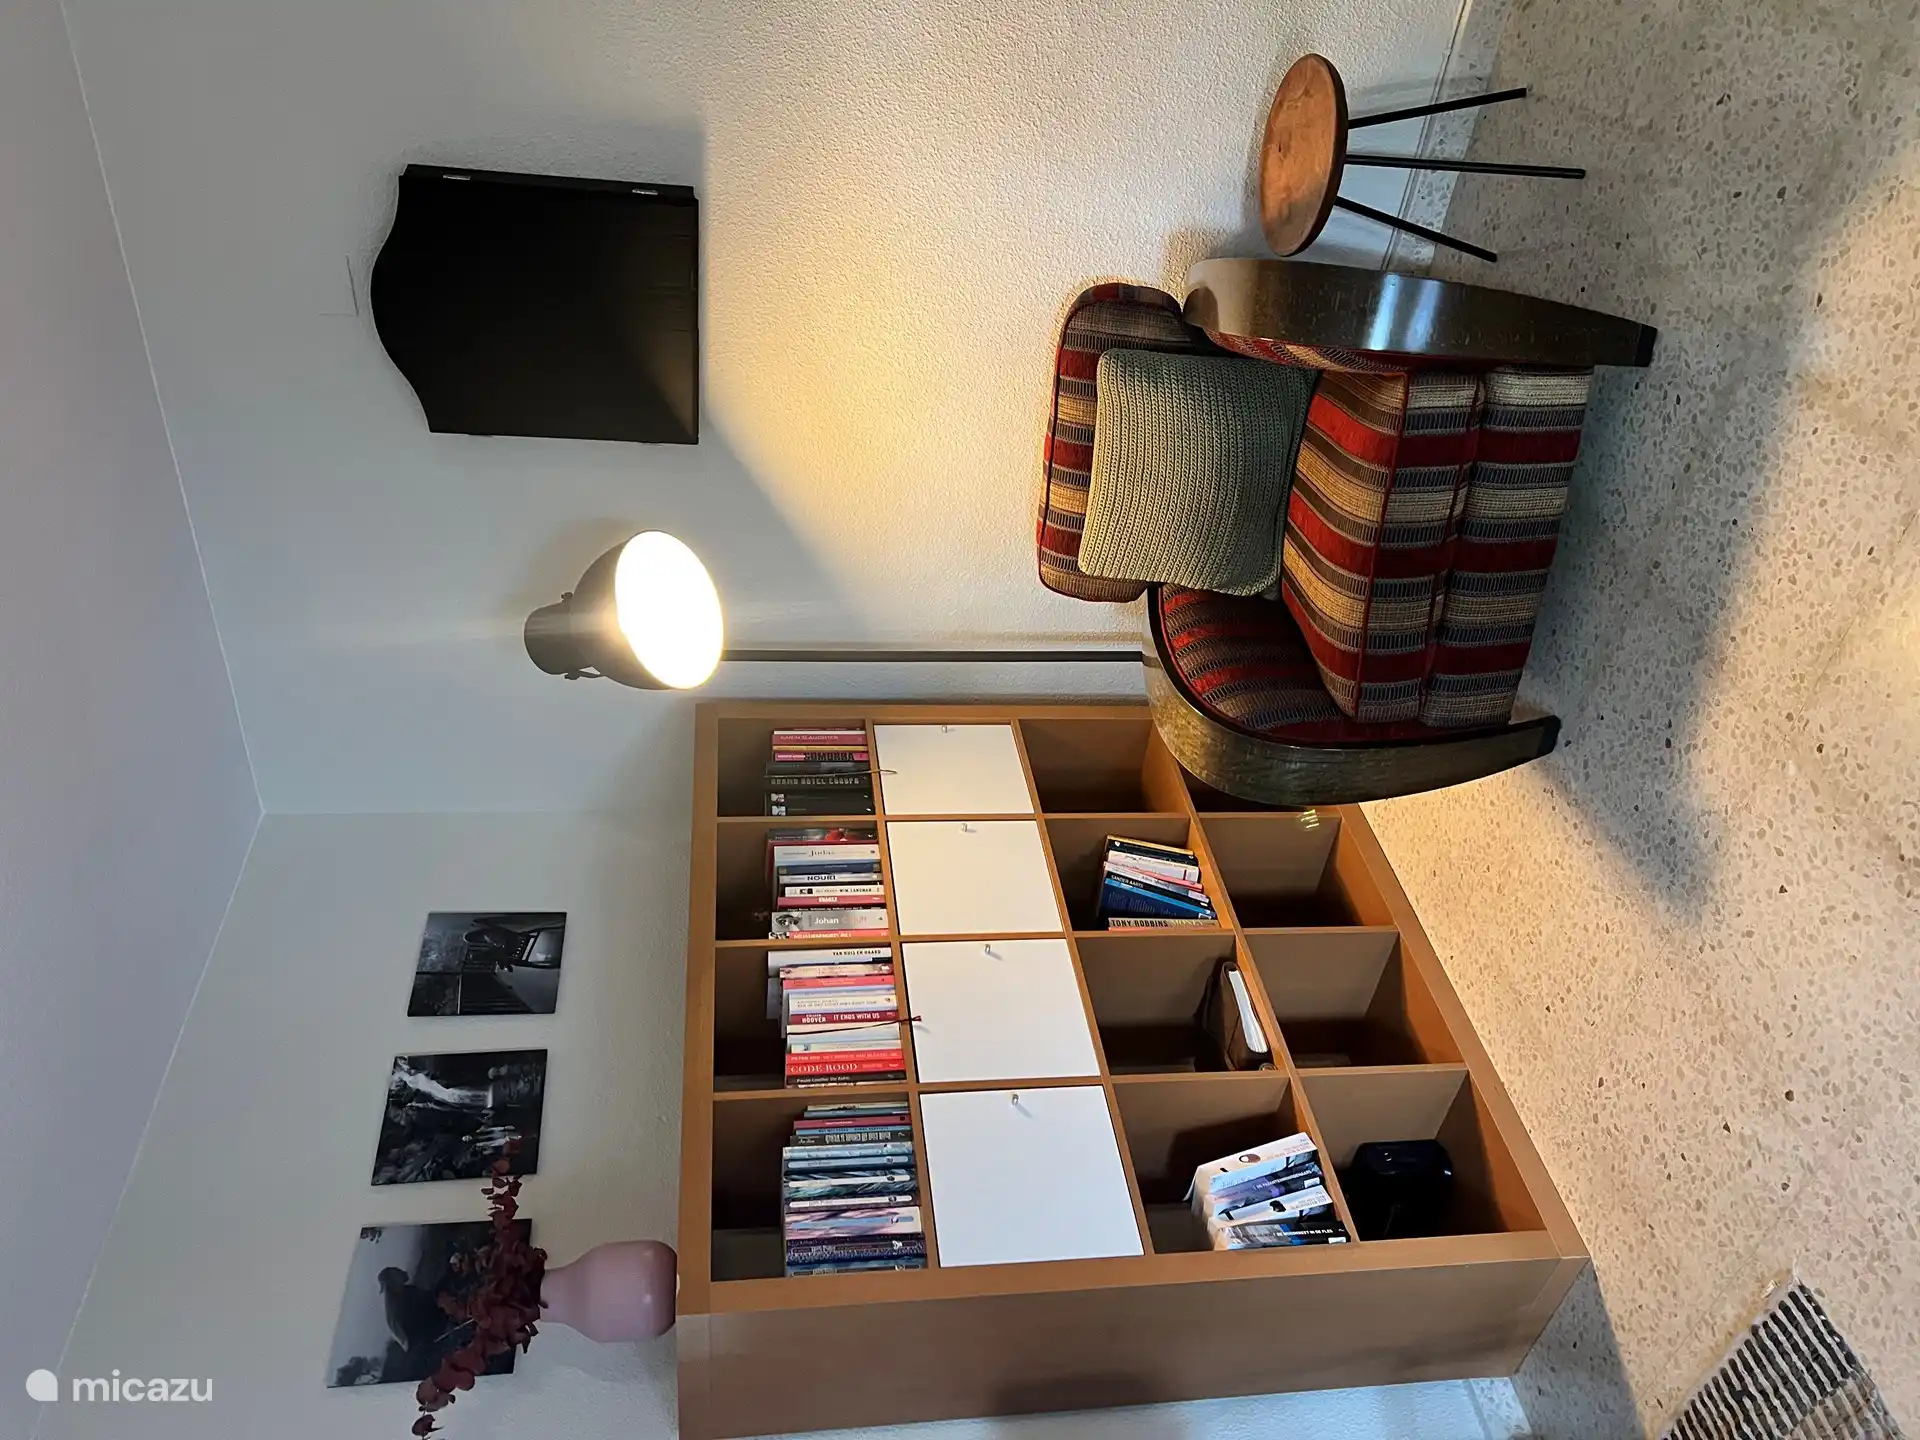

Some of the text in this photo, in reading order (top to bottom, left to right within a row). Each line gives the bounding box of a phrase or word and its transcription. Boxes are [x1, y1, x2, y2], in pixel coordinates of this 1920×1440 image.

[814, 917, 839, 925] Johan
[1110, 919, 1132, 927] TONY
[1134, 919, 1168, 927] ROBBINS
[791, 1065, 823, 1073] CODE
[825, 1063, 858, 1072] ROOD
